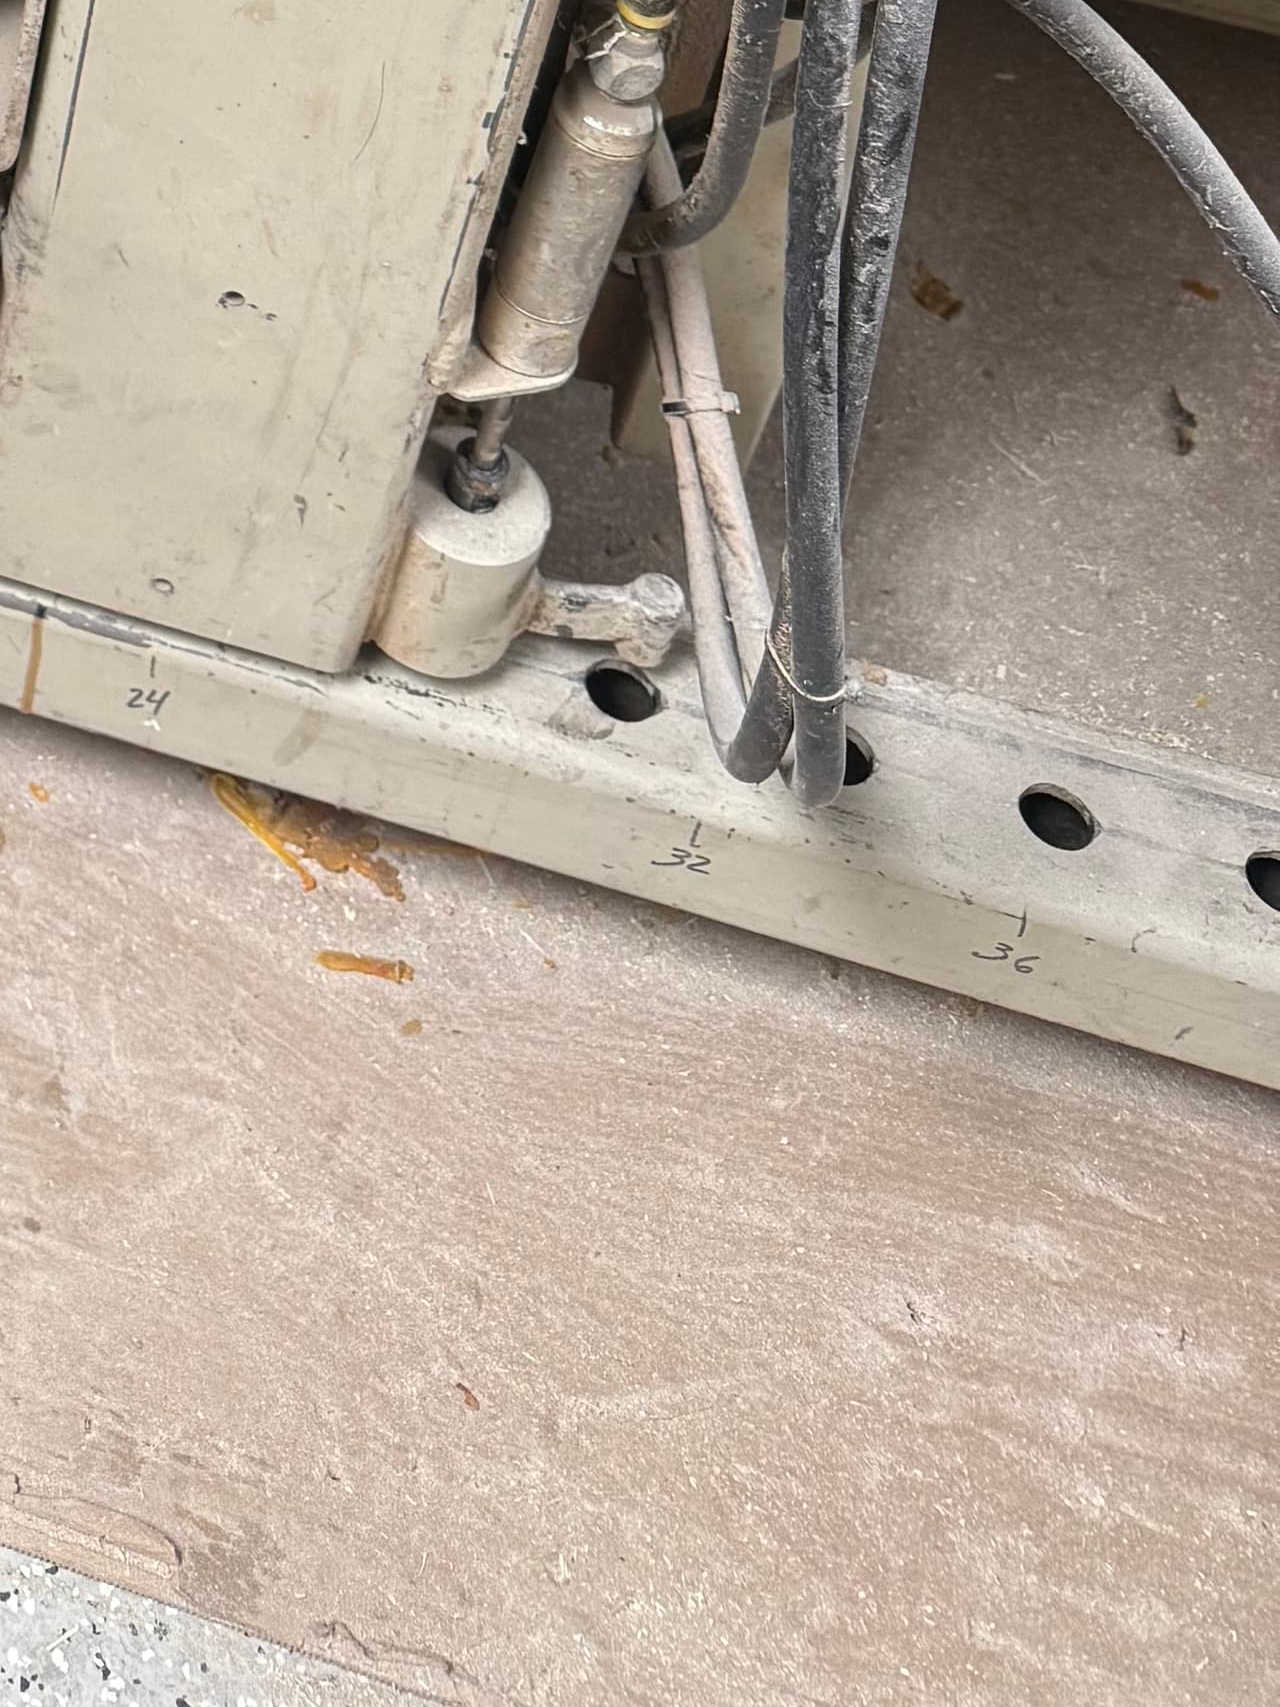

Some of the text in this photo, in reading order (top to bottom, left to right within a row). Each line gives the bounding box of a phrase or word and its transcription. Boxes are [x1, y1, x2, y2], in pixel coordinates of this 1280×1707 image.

[125, 687, 173, 717] 24
[651, 846, 711, 876] 32
[971, 942, 1041, 974] 36
